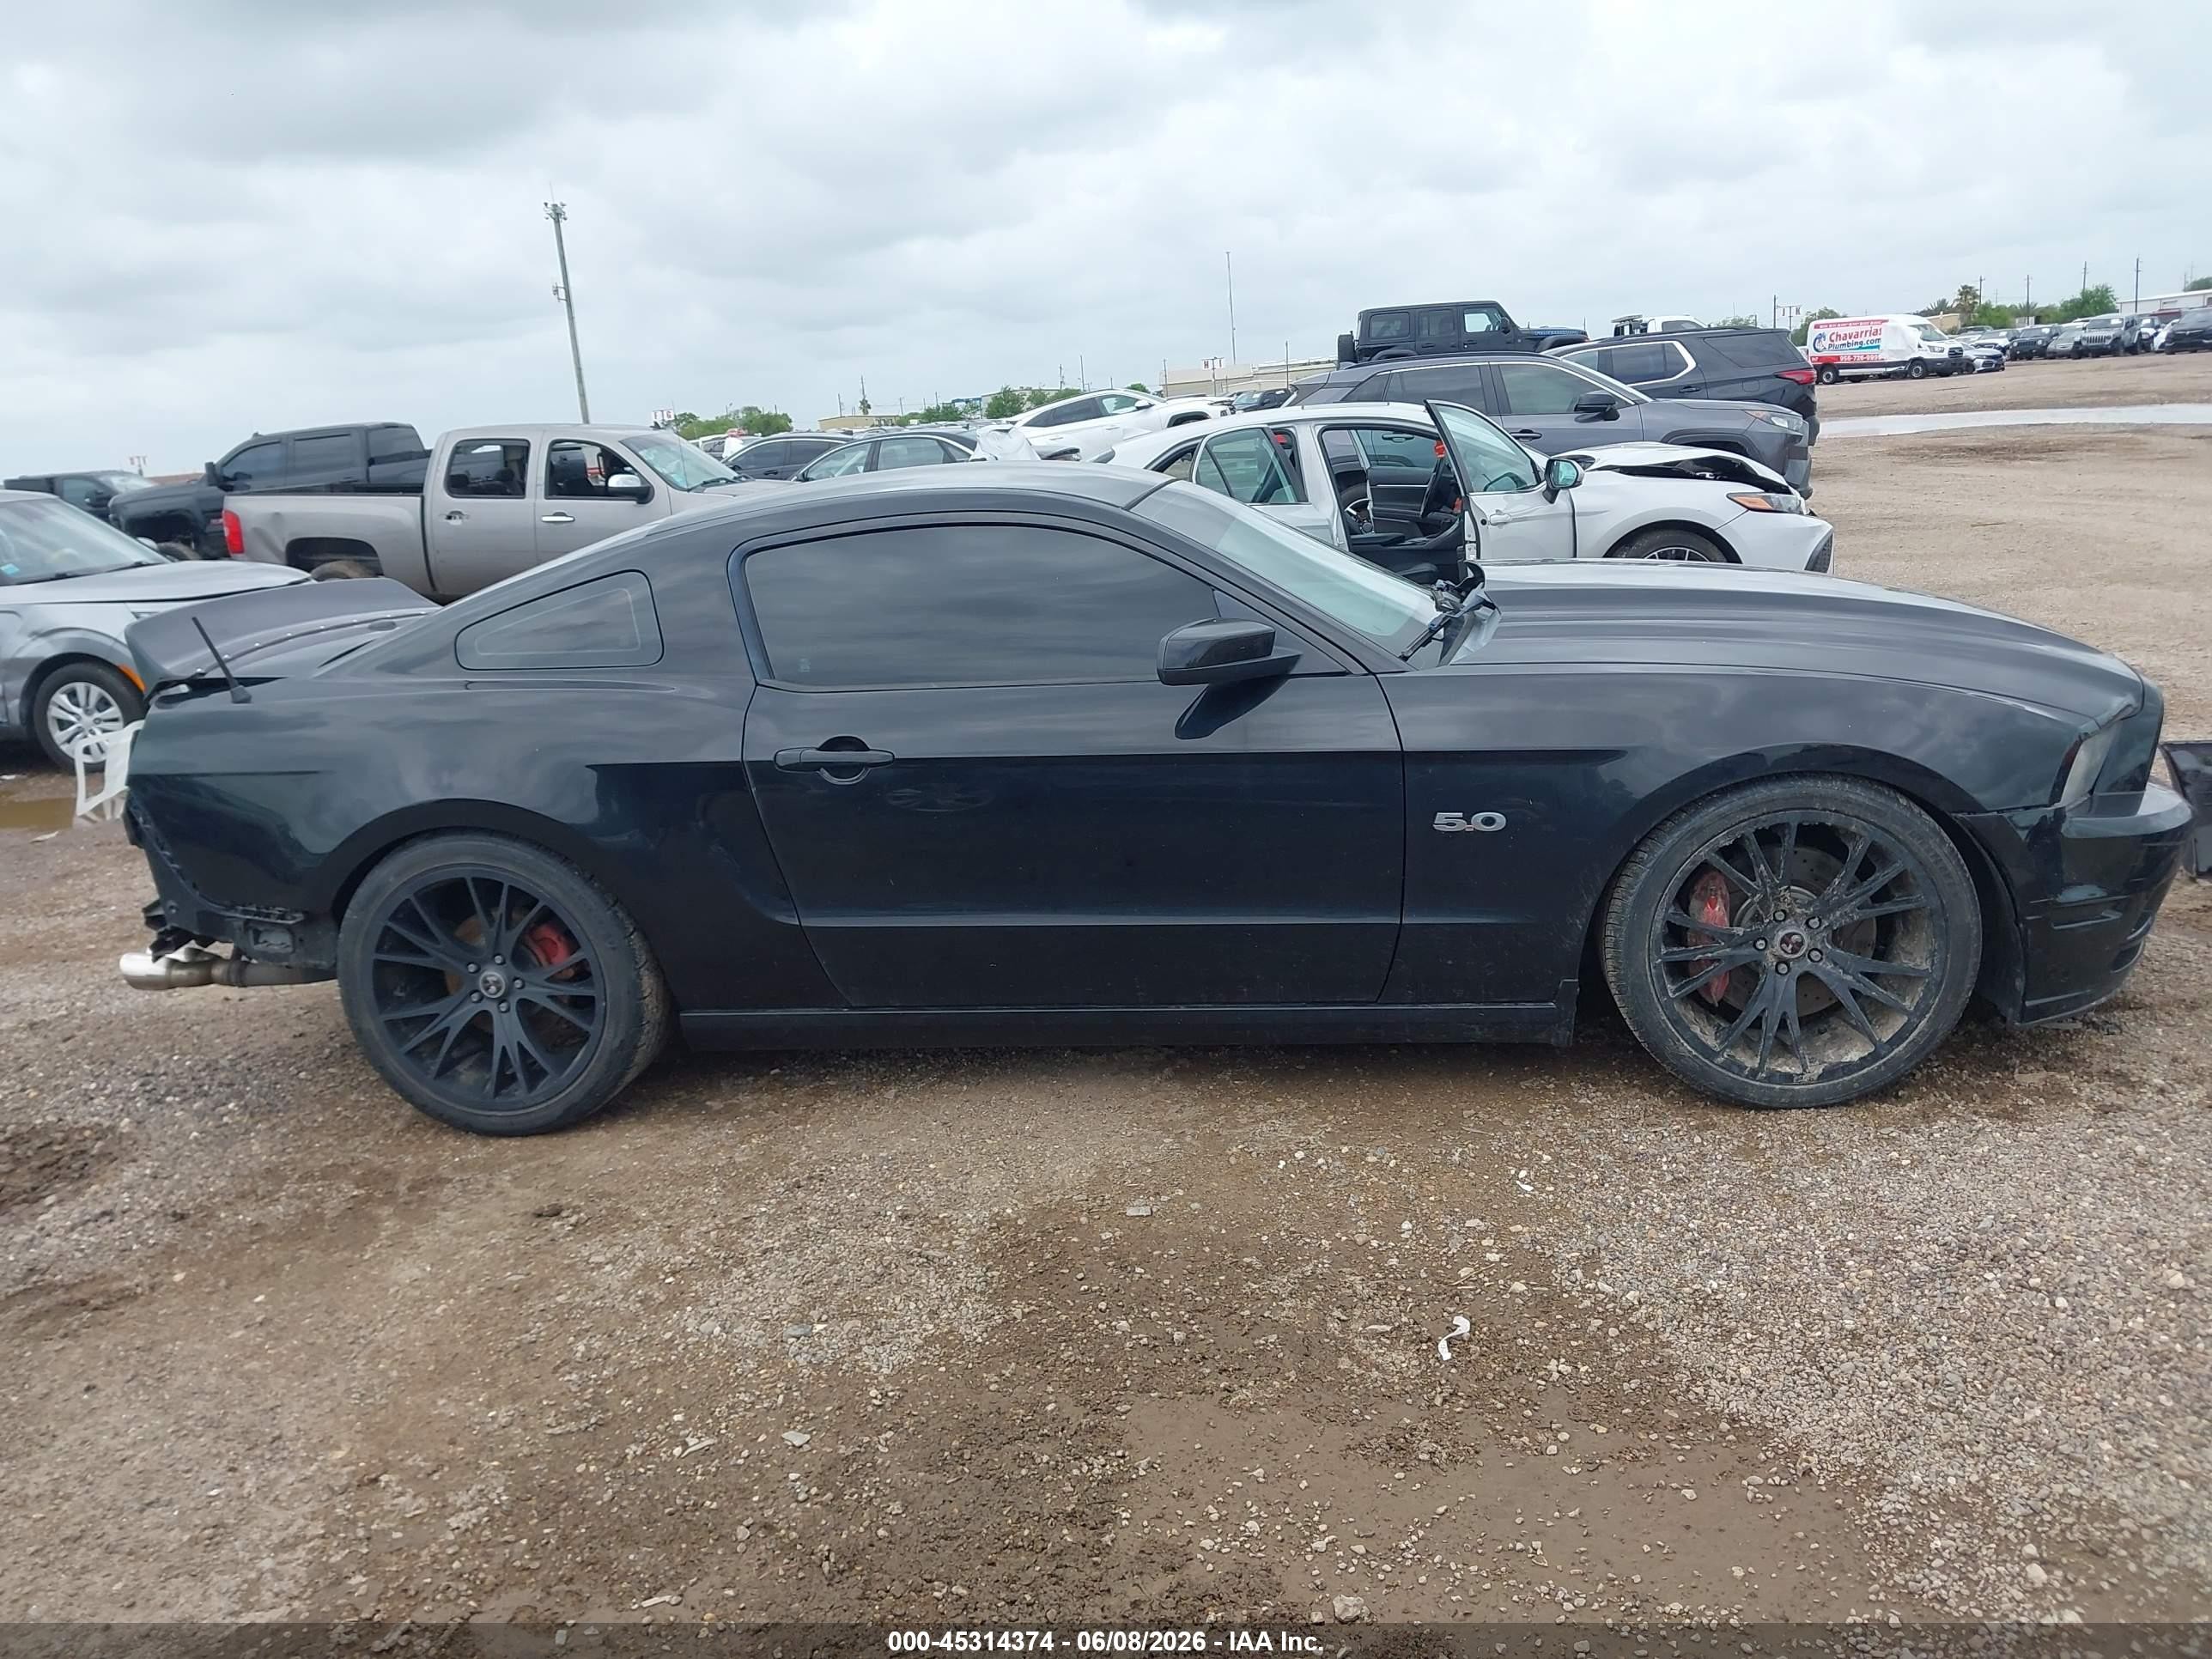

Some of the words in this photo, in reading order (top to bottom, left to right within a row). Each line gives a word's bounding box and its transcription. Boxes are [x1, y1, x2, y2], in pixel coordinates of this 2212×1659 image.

[1828, 337, 1881, 349] Plumbing.com
[1829, 326, 1881, 343] Chavarrias
[1432, 812, 1506, 831] 5.0
